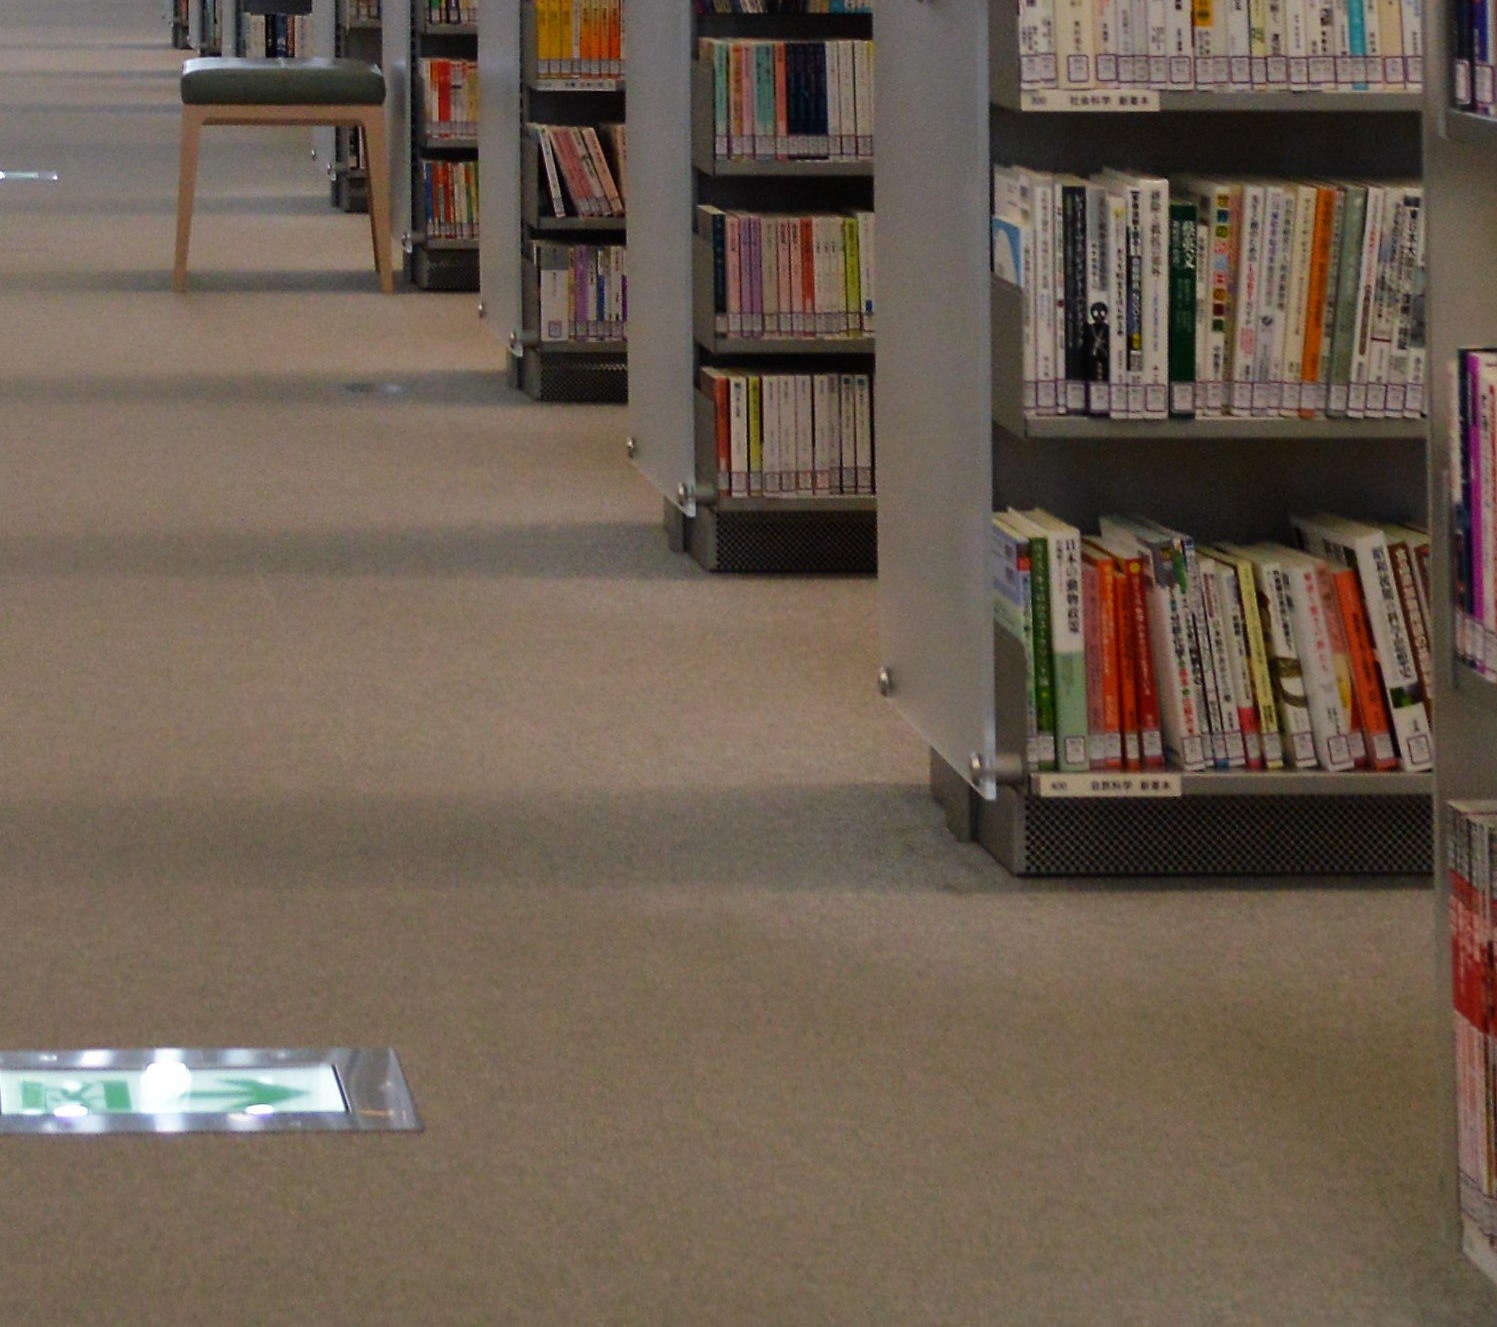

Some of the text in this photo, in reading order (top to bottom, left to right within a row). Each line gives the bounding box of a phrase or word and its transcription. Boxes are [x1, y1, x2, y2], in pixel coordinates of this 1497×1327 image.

[1069, 96, 1111, 107] 社会科学
[1090, 780, 1133, 791] 自然科学
